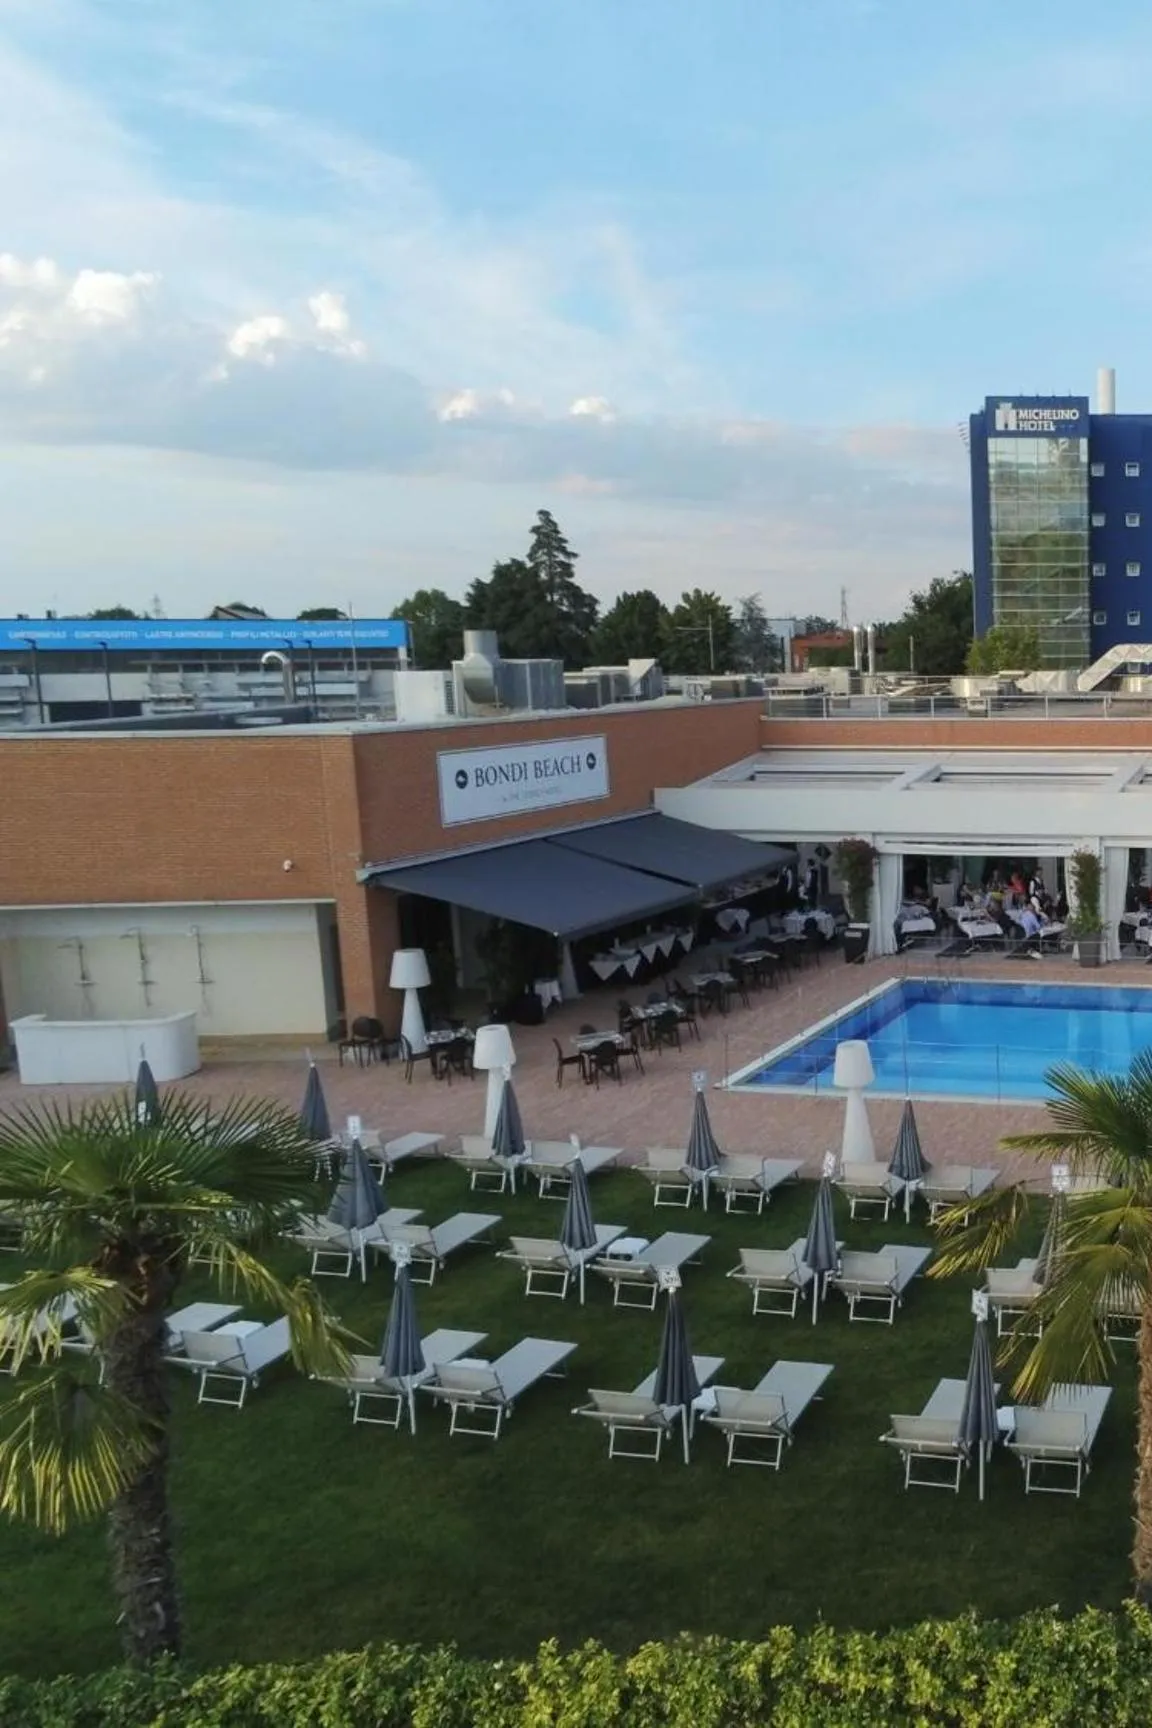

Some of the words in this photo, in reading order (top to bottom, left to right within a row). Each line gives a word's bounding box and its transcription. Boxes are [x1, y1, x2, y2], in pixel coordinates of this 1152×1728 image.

[1019, 409, 1080, 420] MICHELINO
[1019, 421, 1056, 431] HOTEL
[474, 761, 529, 788] BONDI
[533, 754, 582, 780] BEACH
